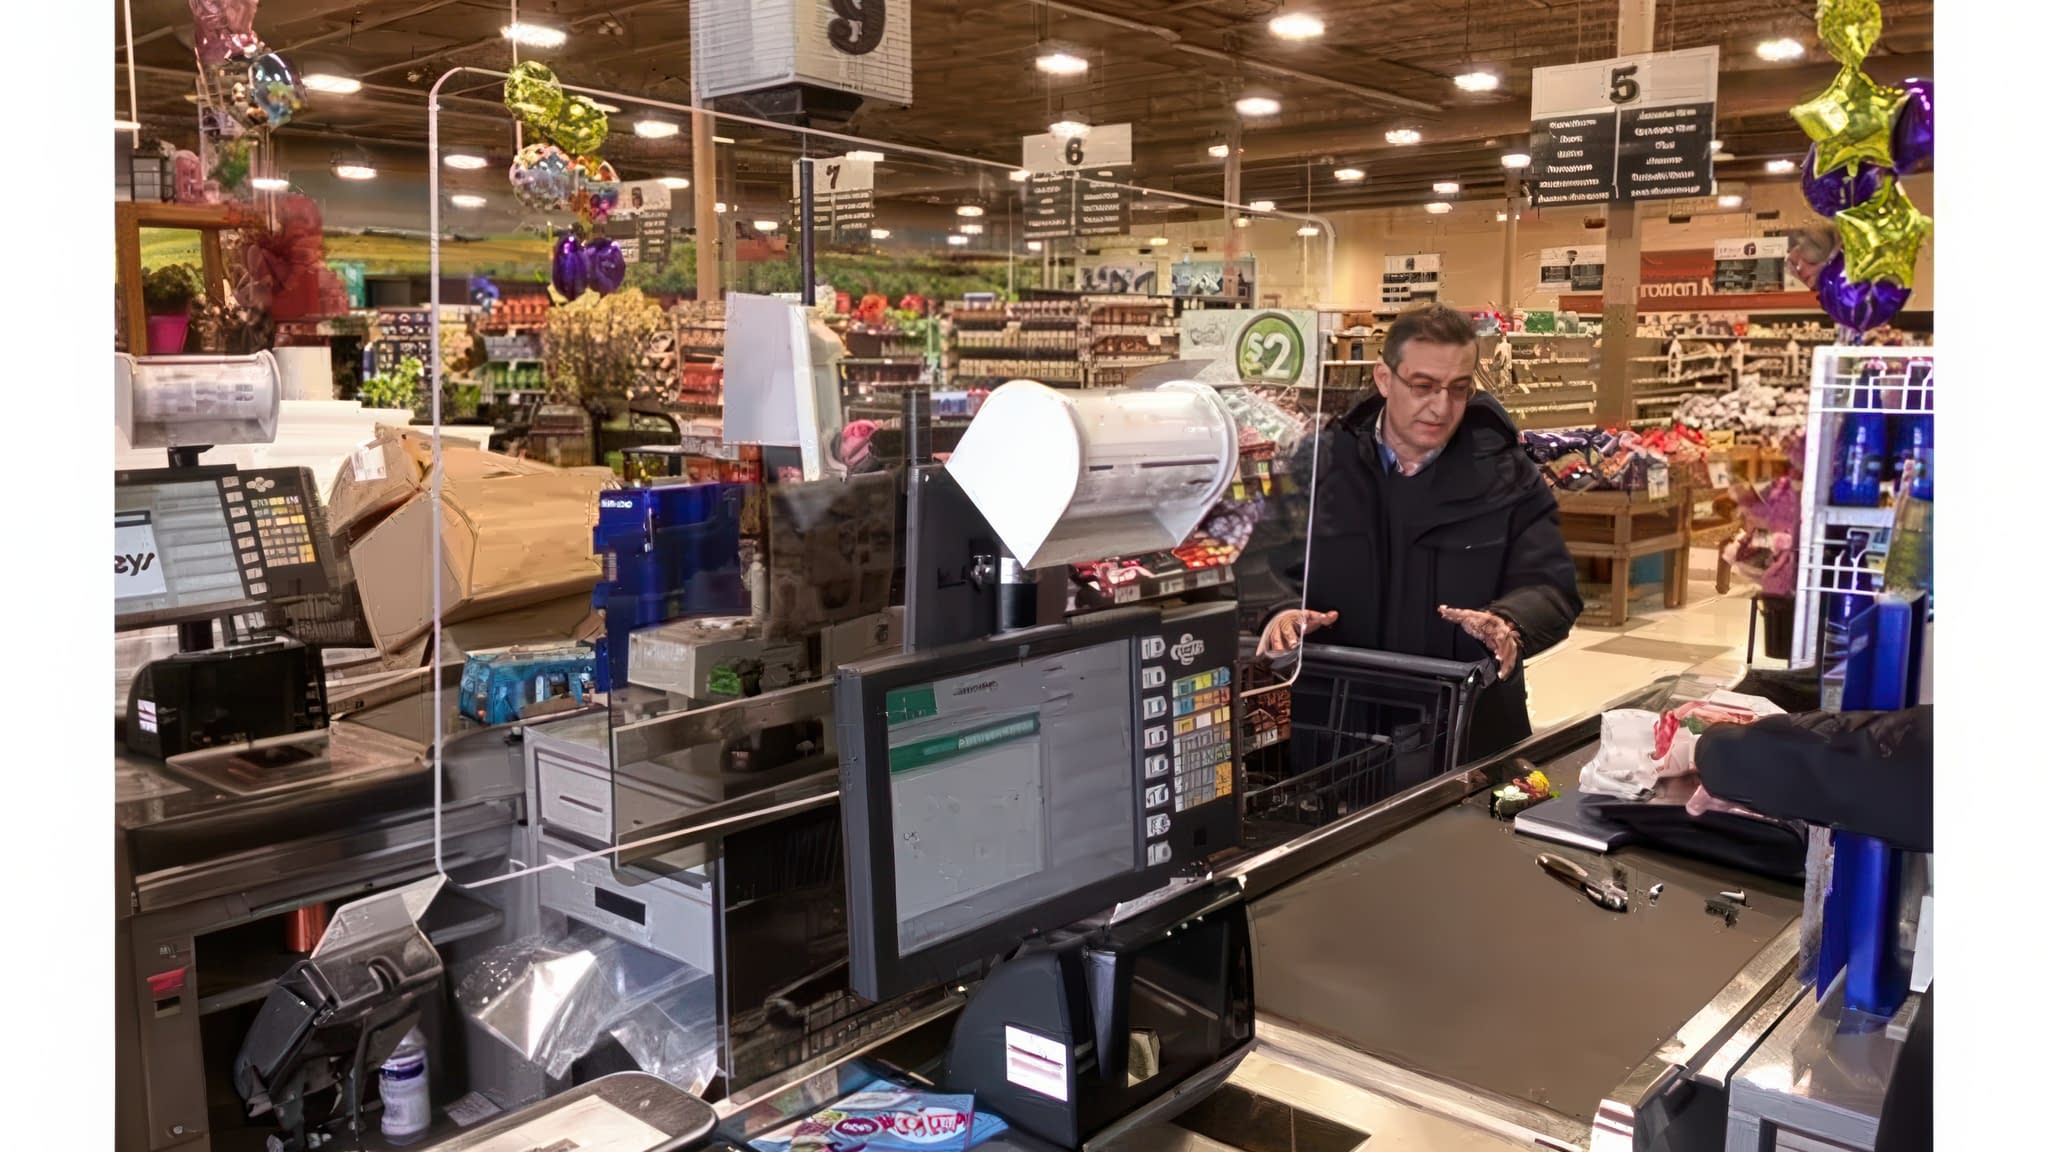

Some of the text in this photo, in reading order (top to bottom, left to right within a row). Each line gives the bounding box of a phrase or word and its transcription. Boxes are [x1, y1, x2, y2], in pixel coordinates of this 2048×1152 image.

[828, 0, 886, 55] 9
[1609, 65, 1640, 104] 5
[1065, 137, 1084, 165] 6
[826, 164, 841, 190] 7
